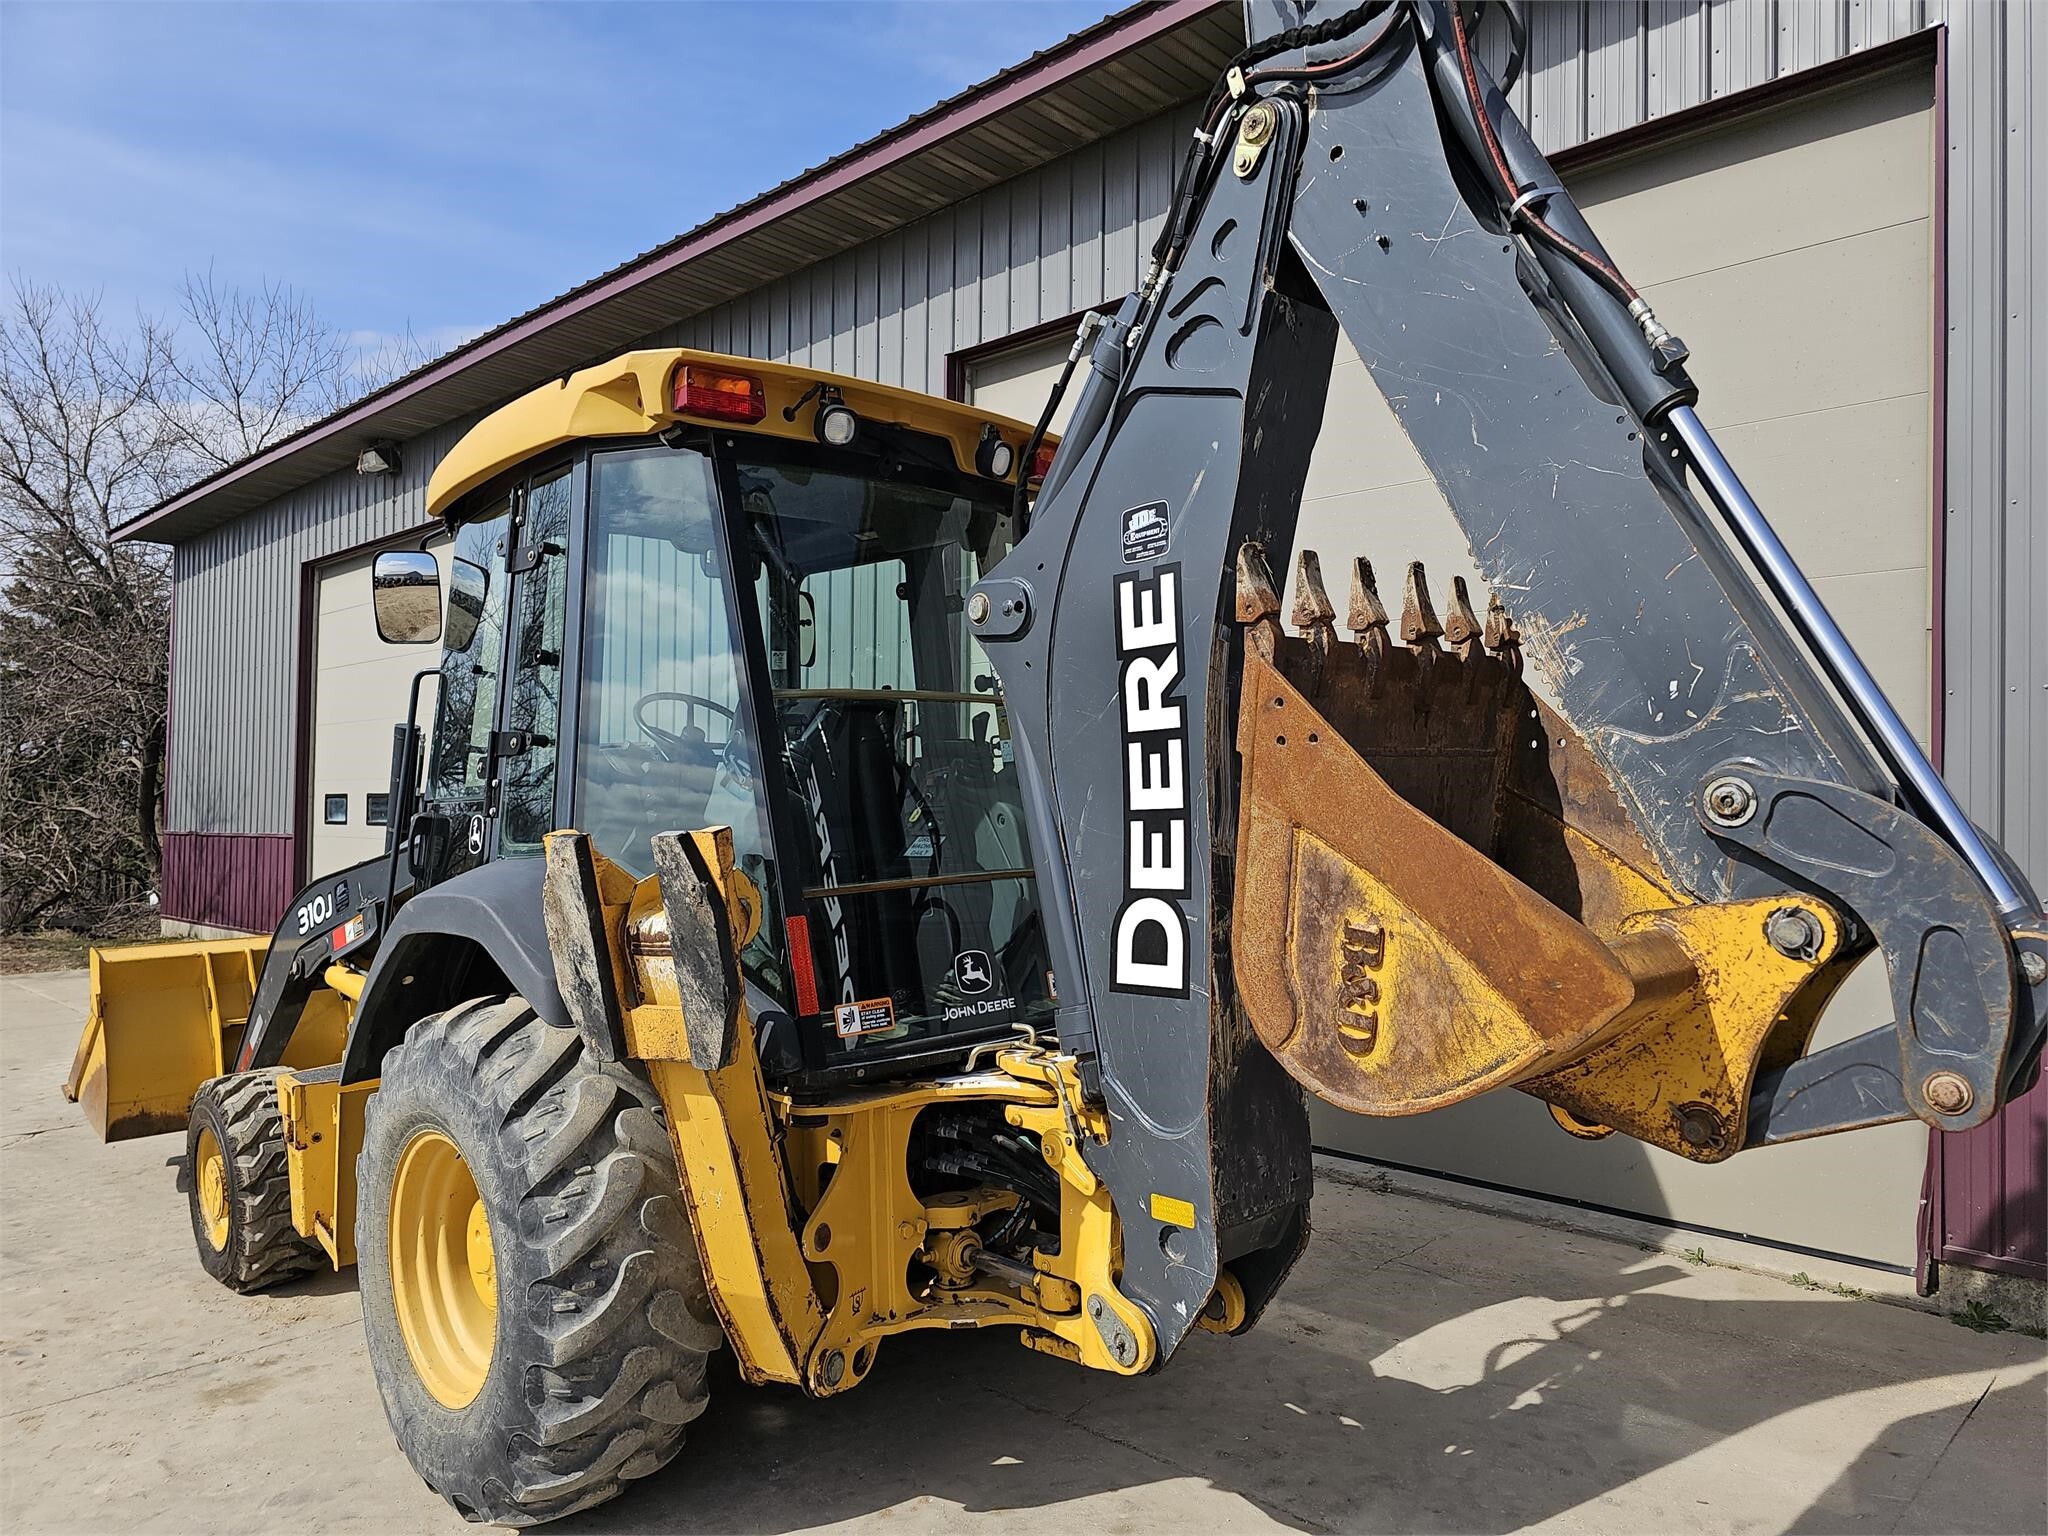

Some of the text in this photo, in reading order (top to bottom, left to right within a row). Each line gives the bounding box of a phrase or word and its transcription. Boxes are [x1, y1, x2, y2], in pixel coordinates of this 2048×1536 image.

[1116, 571, 1185, 990] DEERE
[297, 892, 333, 936] 310J
[942, 998, 1016, 1021] JOHN DEERE
[1337, 917, 1386, 1059] B&D
